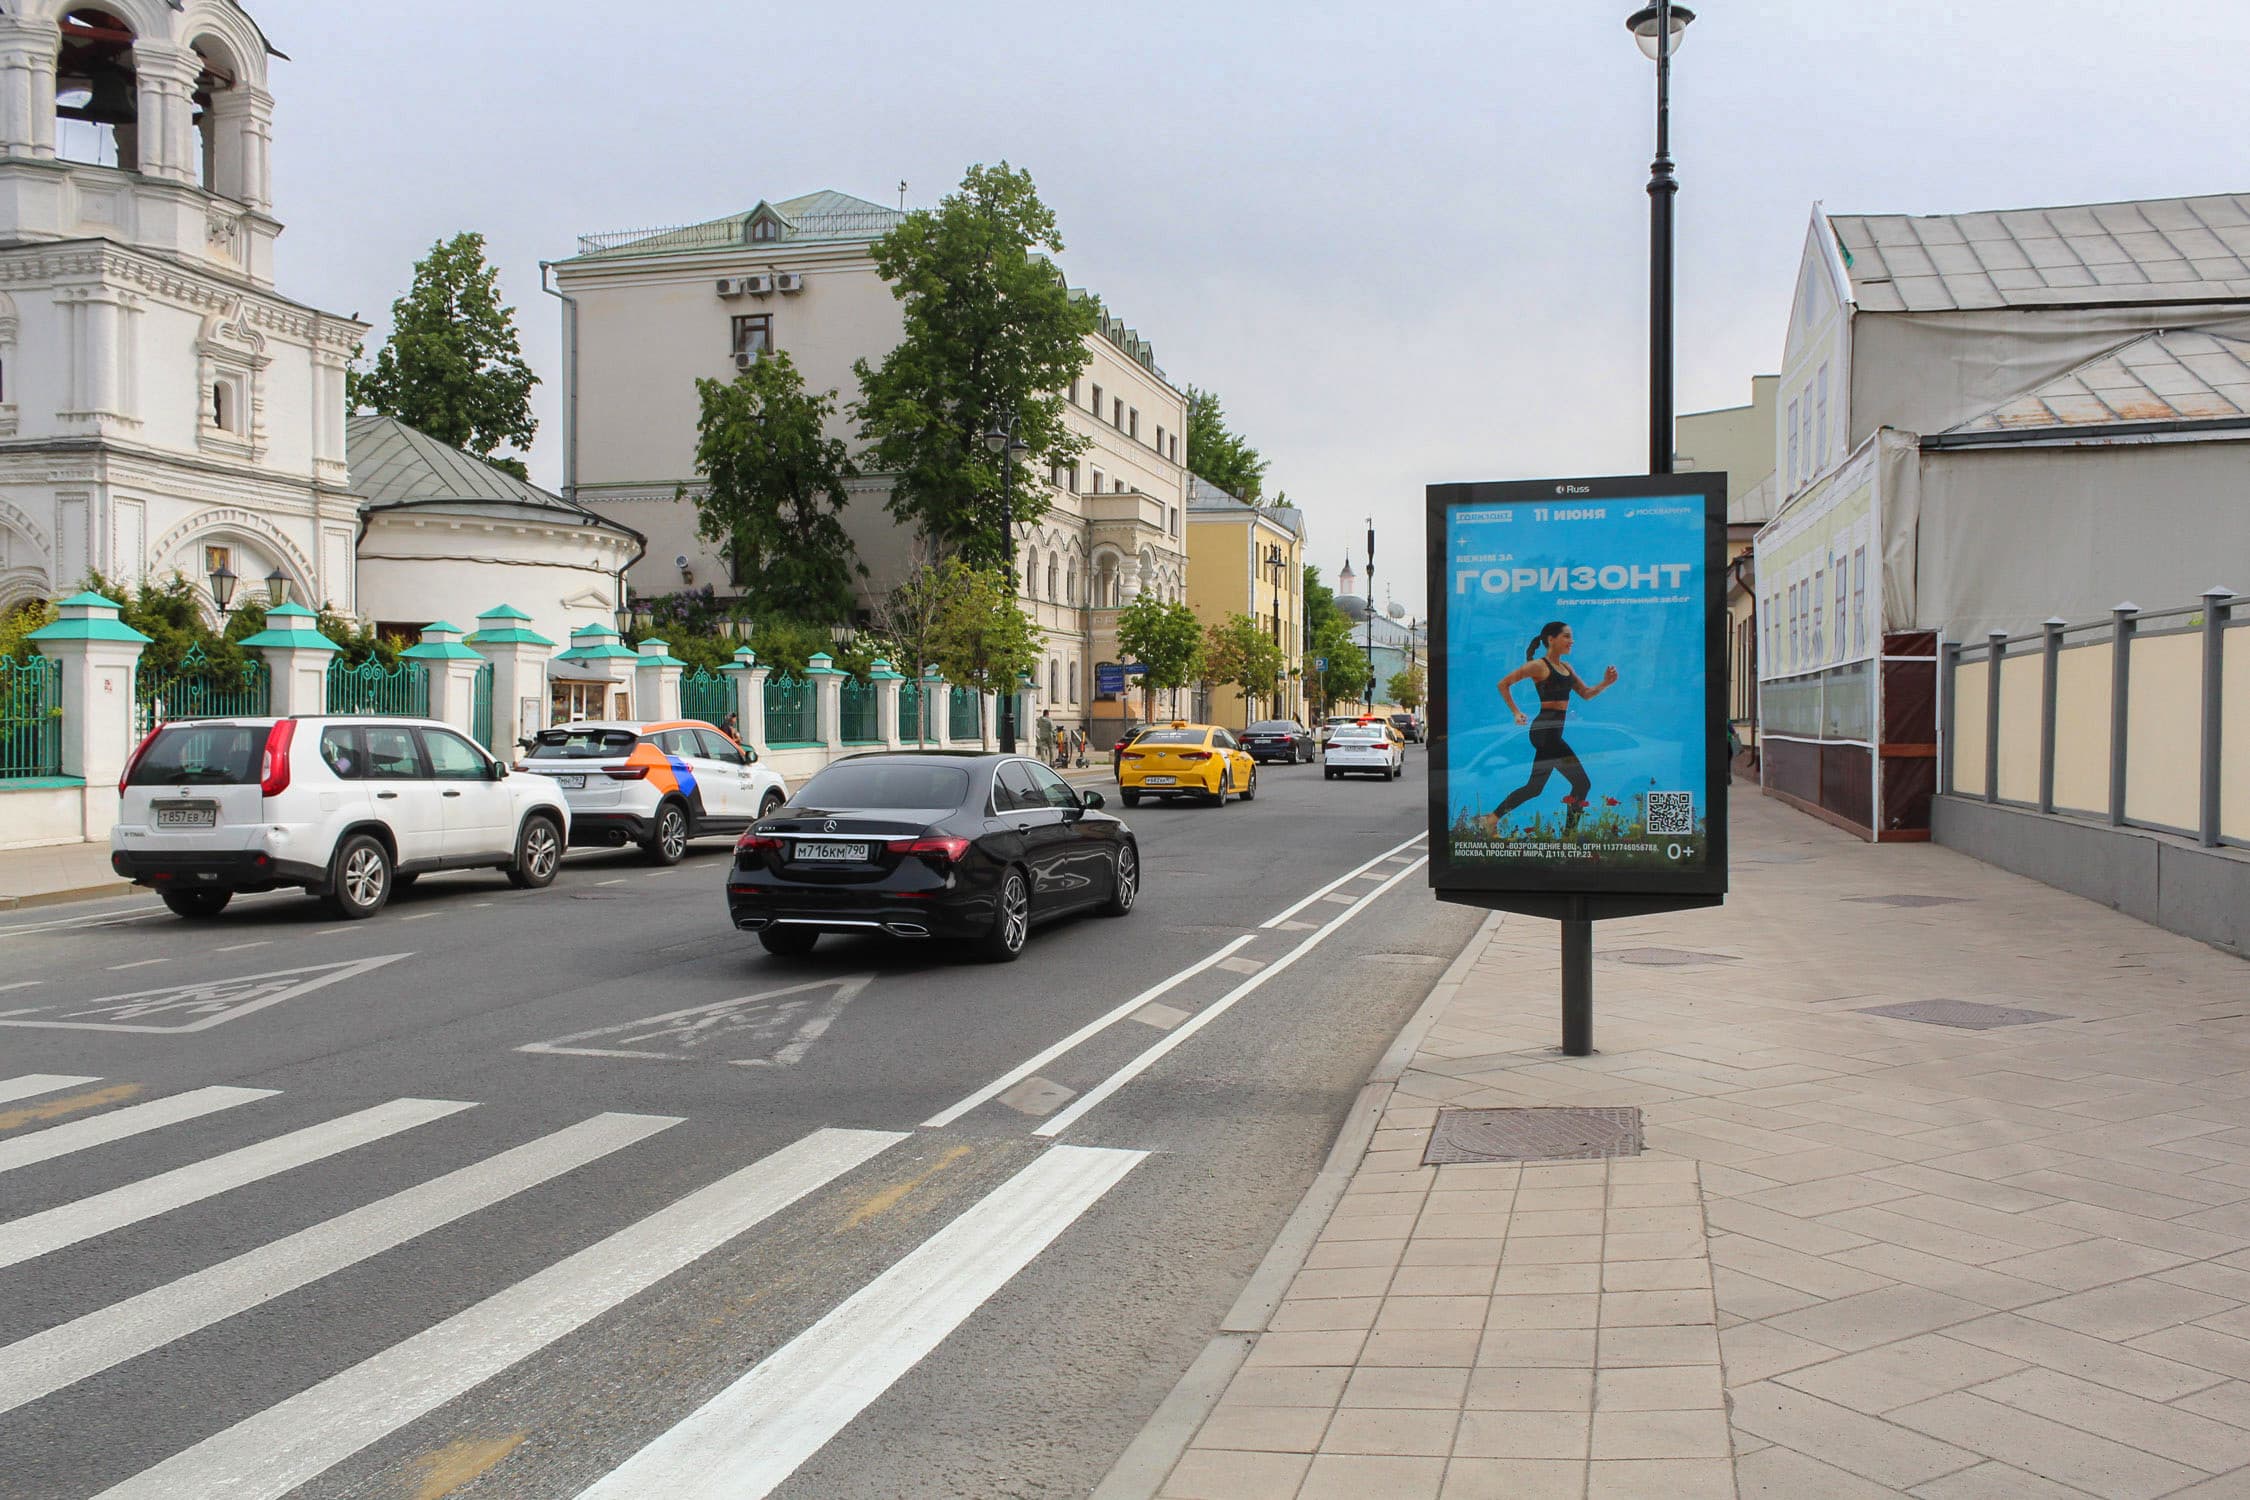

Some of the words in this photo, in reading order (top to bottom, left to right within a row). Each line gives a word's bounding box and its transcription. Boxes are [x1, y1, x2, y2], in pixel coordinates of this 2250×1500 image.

[1566, 485, 1590, 494] Russ
[1534, 508, 1549, 521] 11
[1498, 553, 1514, 561] ЗА
[1456, 564, 1691, 594] ГОРИЗОНТ
[847, 845, 866, 855] 790
[1490, 842, 1505, 850] ООО
[1582, 843, 1601, 851] ОГРН
[1666, 843, 1695, 860] 0+
